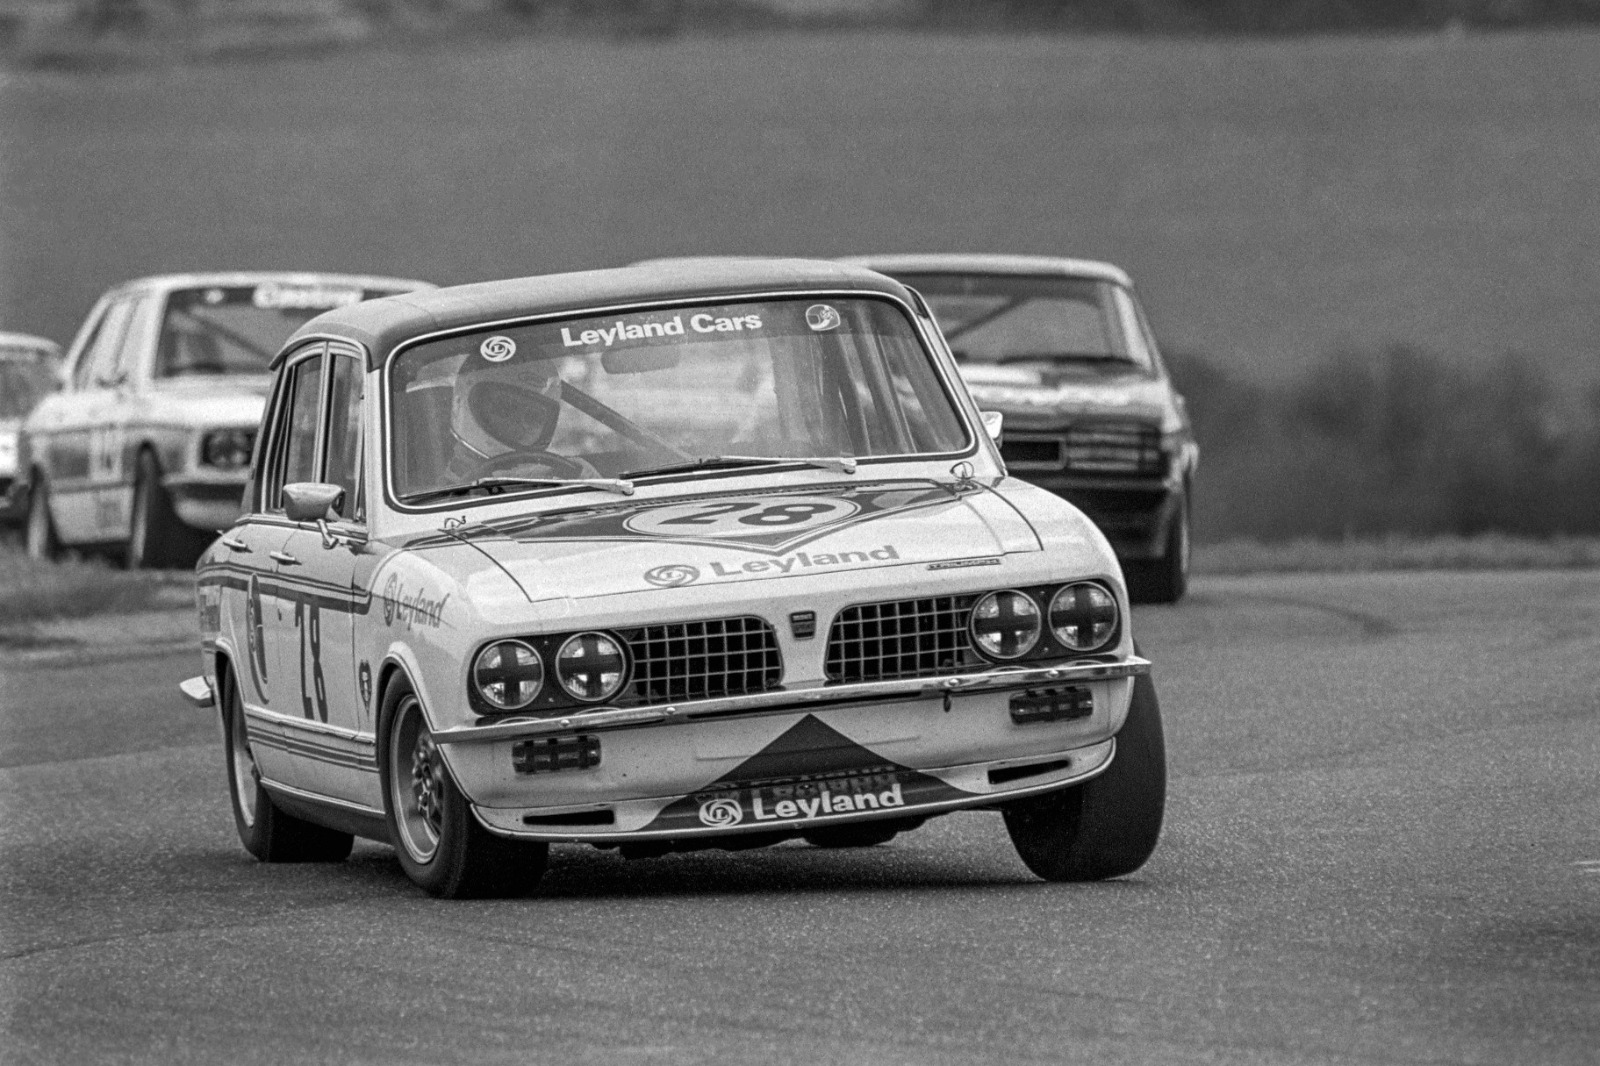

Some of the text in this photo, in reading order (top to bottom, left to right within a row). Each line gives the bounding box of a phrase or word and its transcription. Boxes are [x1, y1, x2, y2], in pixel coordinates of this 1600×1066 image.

[561, 313, 763, 347] Leyland Cars
[657, 502, 836, 526] 28
[710, 545, 898, 575] Leyland
[396, 583, 450, 631] Leyland
[752, 783, 904, 820] Leyland
